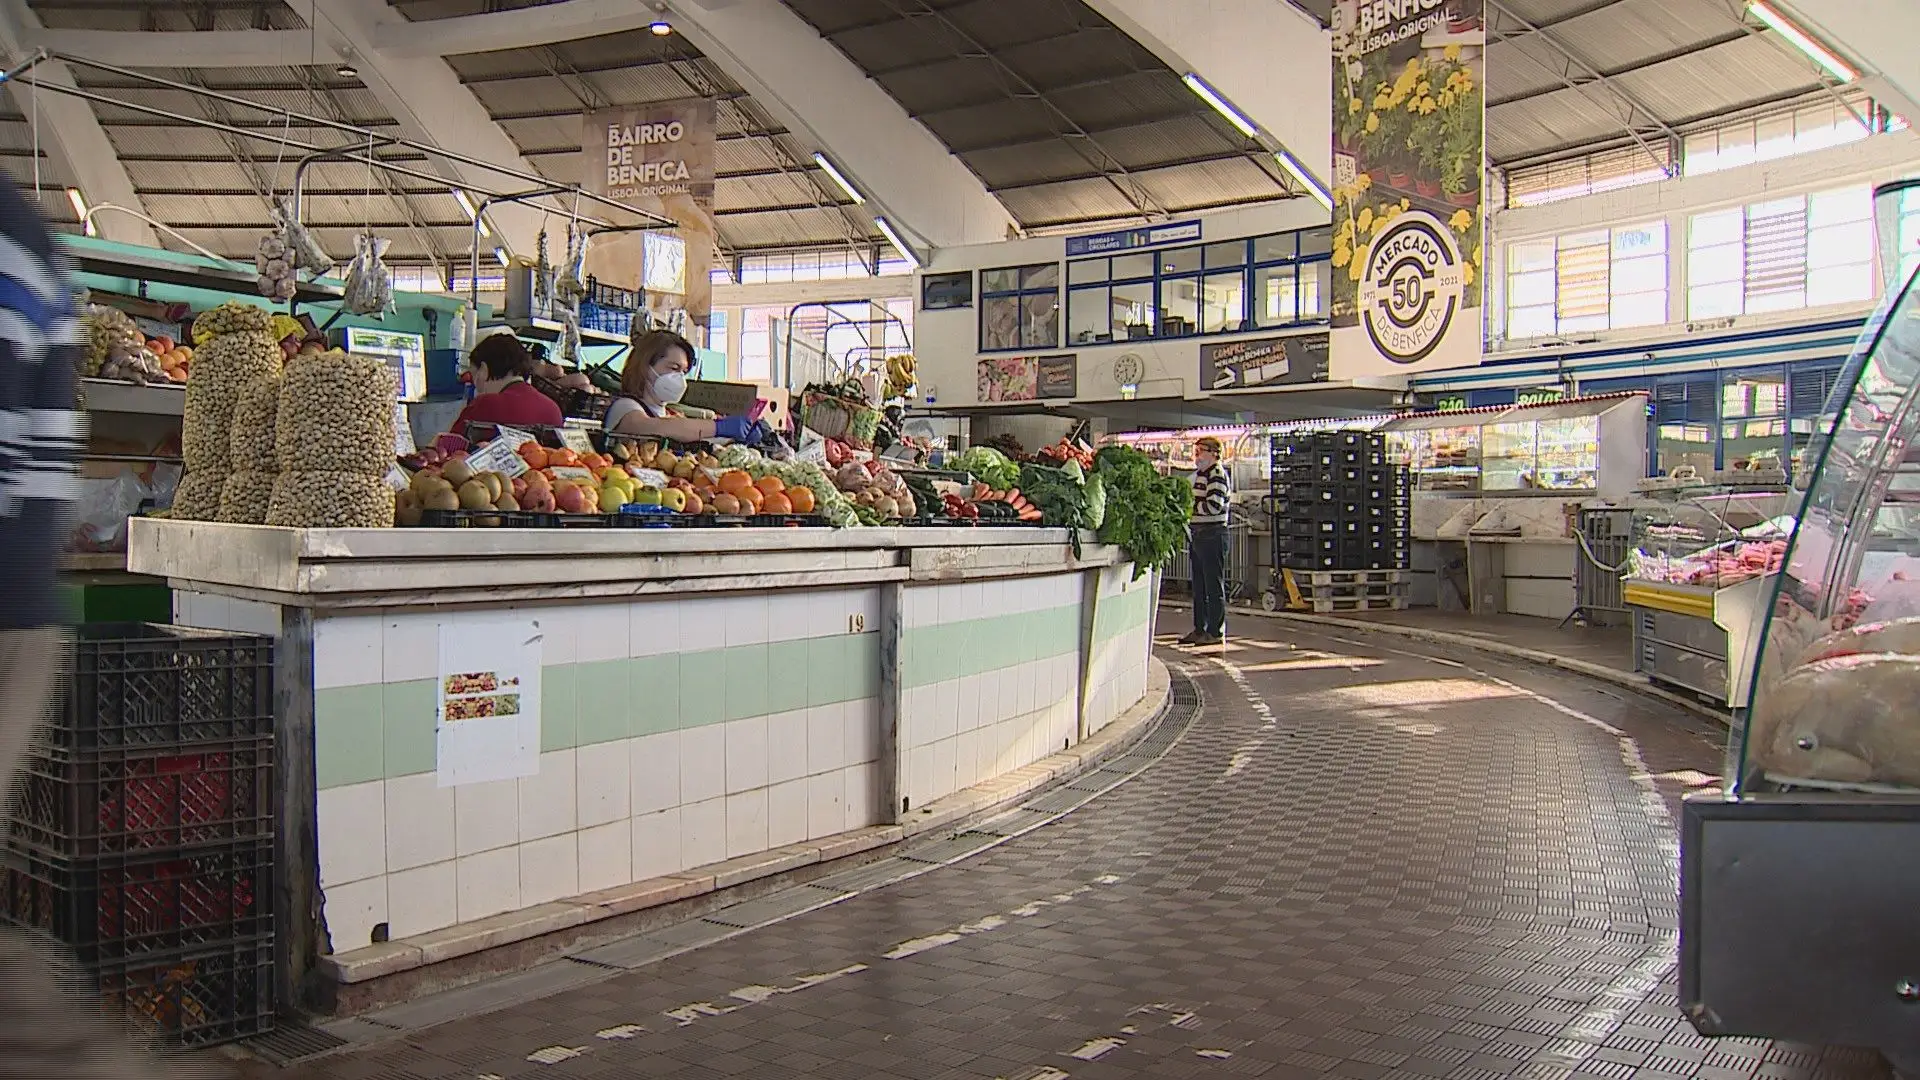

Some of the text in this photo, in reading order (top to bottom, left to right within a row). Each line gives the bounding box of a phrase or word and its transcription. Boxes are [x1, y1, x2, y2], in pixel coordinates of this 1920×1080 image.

[1360, 0, 1443, 35] BENF
[607, 121, 684, 147] BAIRRO
[607, 146, 633, 167] DE
[607, 160, 690, 186] BENFICA
[1375, 236, 1438, 275] MERCADO
[1393, 275, 1420, 310] 50
[1441, 276, 1458, 287] 2021
[1377, 315, 1392, 340] DE
[1391, 308, 1441, 349] BENFICA
[1212, 342, 1246, 360] COMPRE
[849, 613, 864, 632] 19
